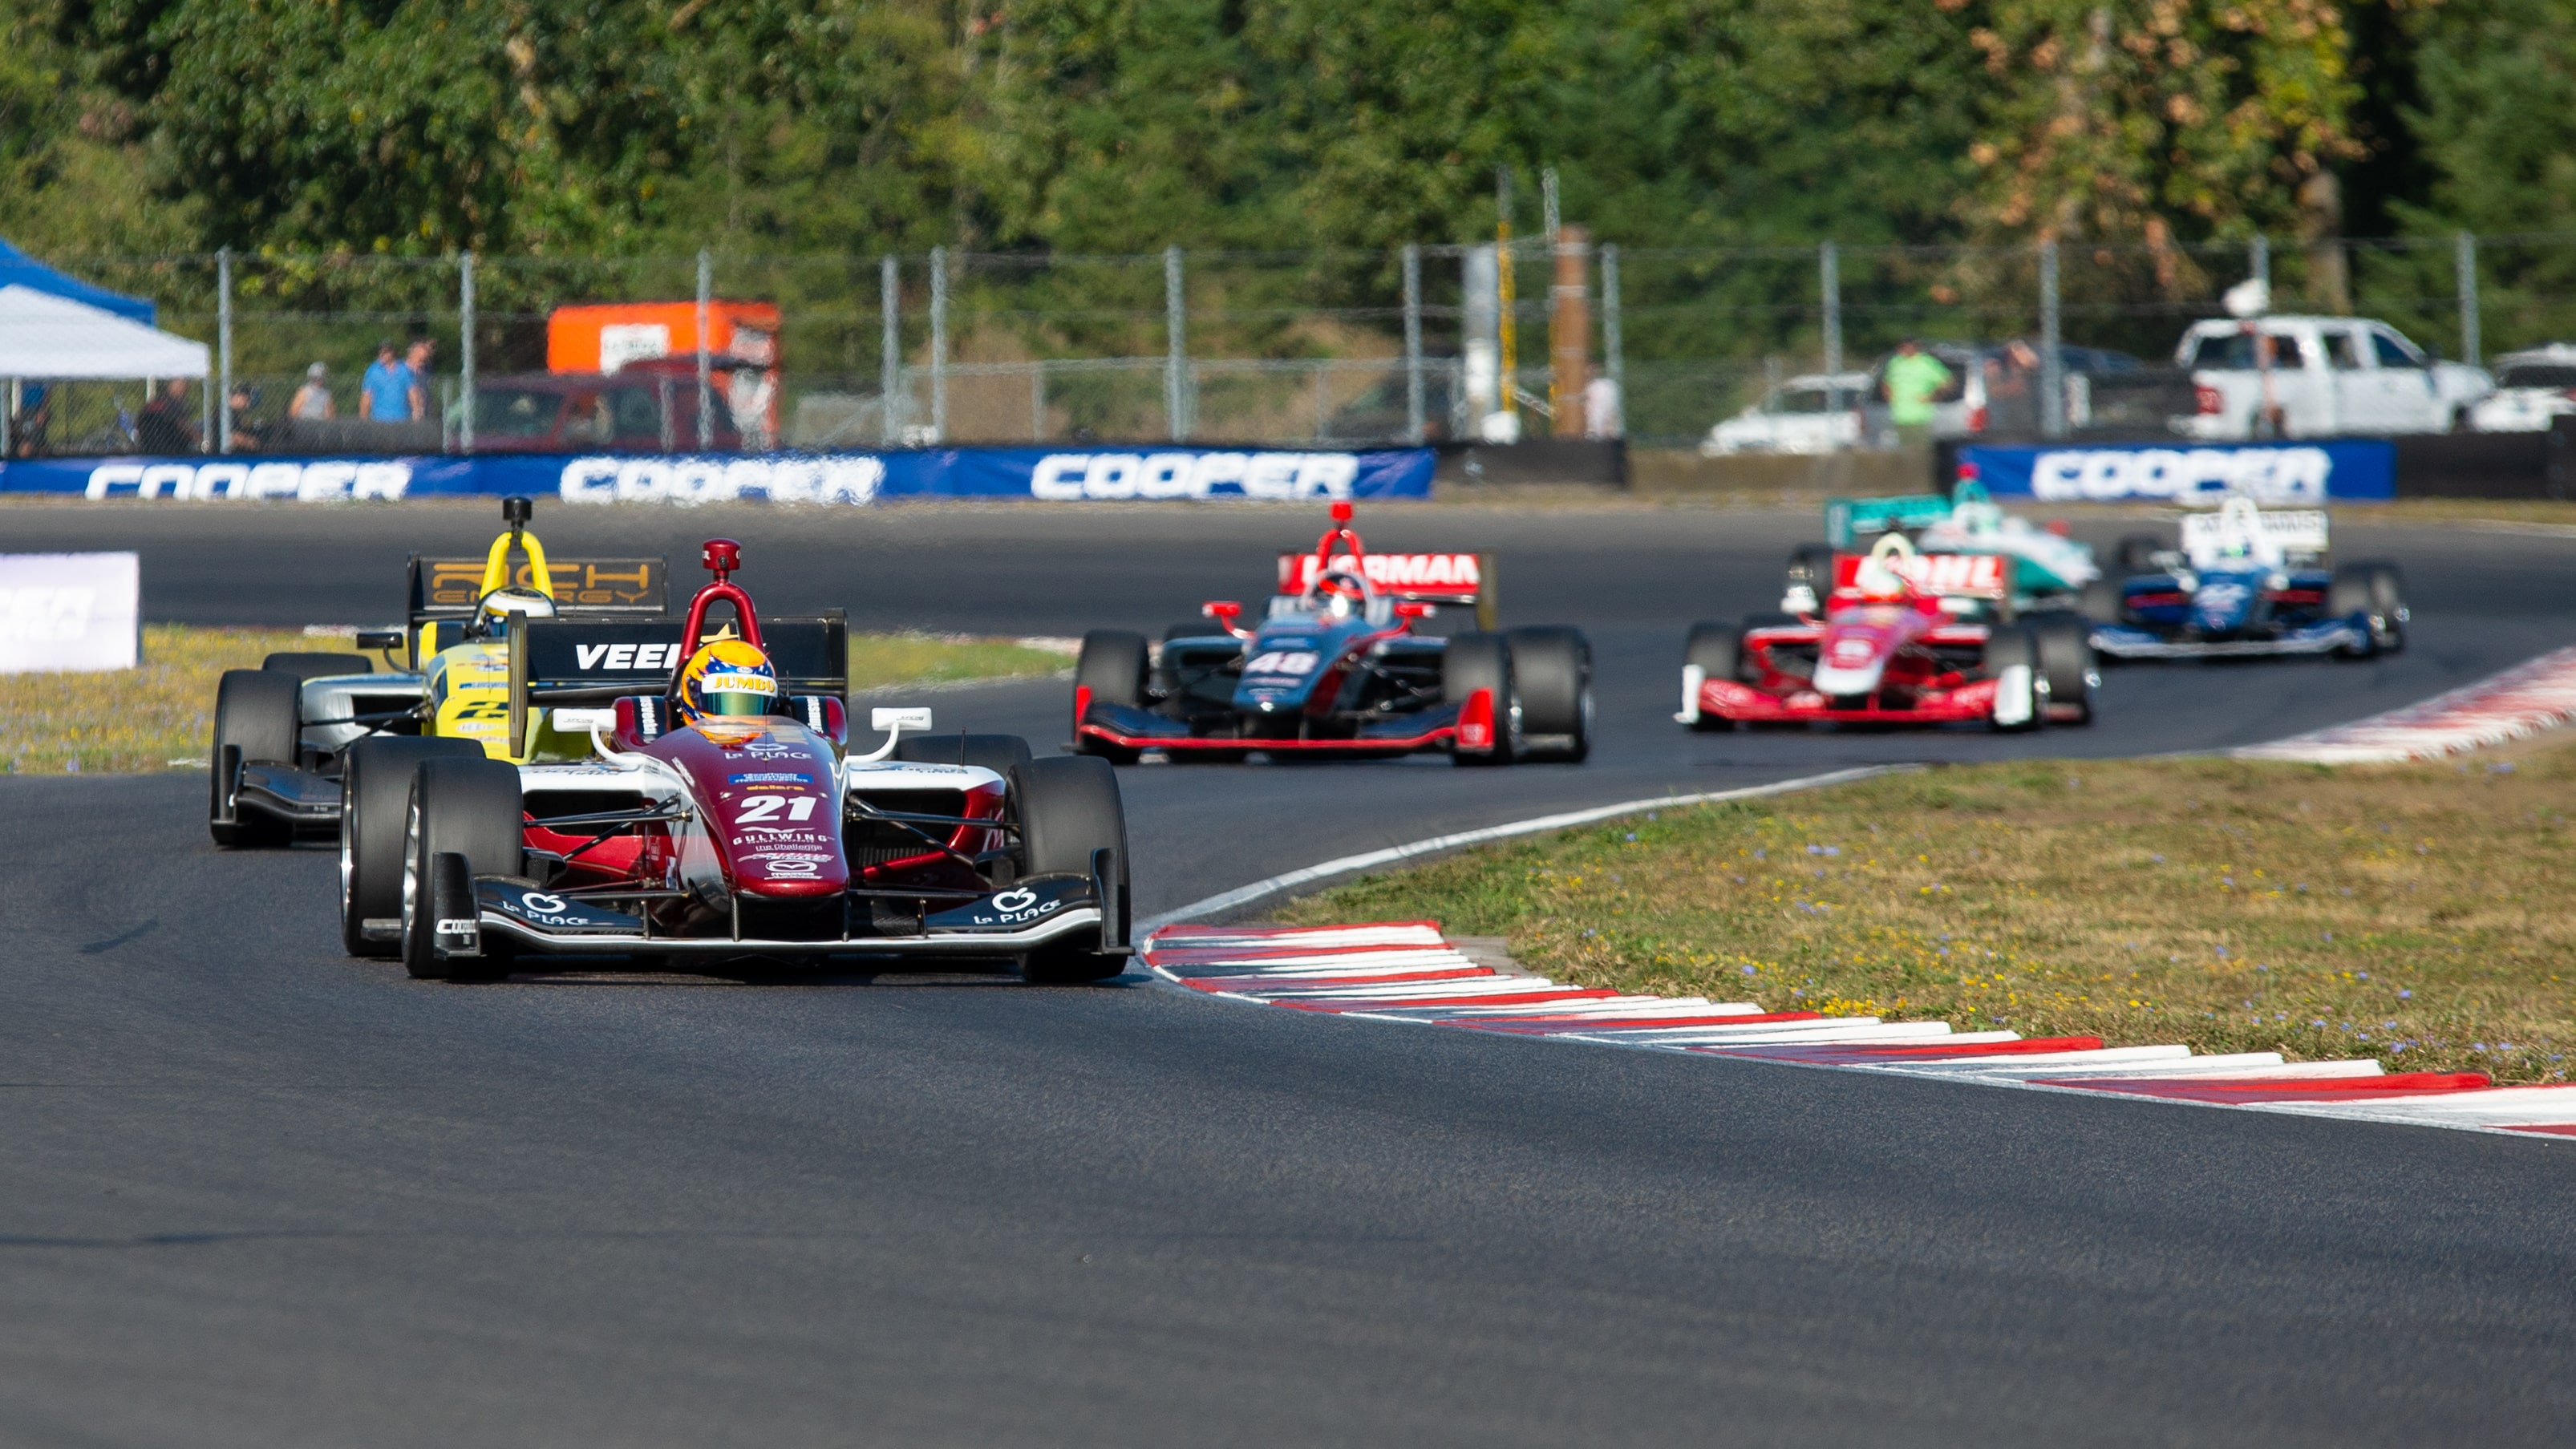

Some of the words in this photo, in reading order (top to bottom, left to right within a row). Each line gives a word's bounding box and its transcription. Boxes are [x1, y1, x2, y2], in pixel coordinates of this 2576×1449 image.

[85, 463, 412, 501] COOPER
[559, 455, 886, 506] COOPER
[1031, 452, 1359, 500] COOPER
[2032, 448, 2333, 502] COOPER
[1244, 651, 1320, 675] 48
[713, 675, 776, 693] JUMBO
[751, 751, 812, 759] PLACE
[735, 795, 816, 824] 21
[733, 833, 828, 846] GULLWING
[526, 909, 589, 925] PLACE
[974, 915, 993, 924] La
[999, 899, 1061, 923] PLACE
